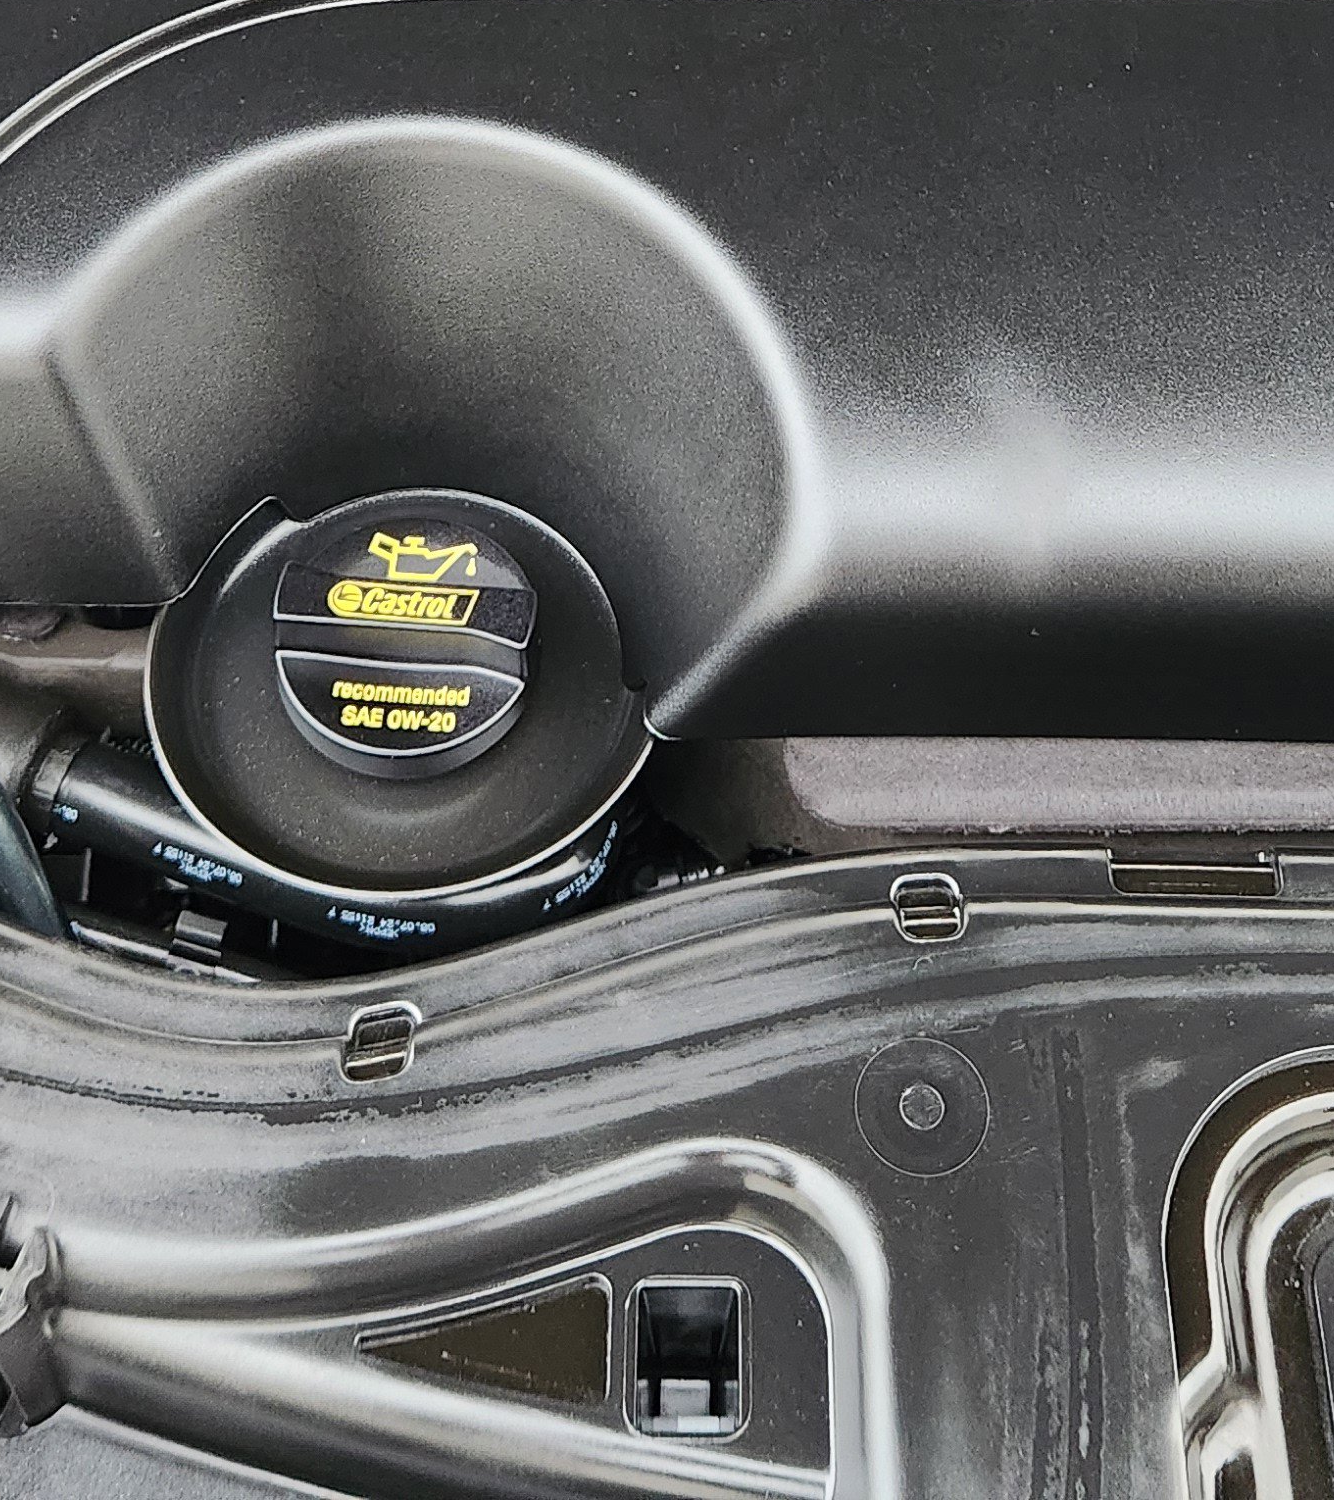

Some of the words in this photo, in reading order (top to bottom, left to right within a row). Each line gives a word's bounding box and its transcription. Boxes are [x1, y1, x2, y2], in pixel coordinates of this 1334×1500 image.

[361, 587, 458, 619] Castrol
[332, 680, 471, 707] recommended
[341, 705, 385, 729] SAE
[386, 708, 457, 734] 0W-20
